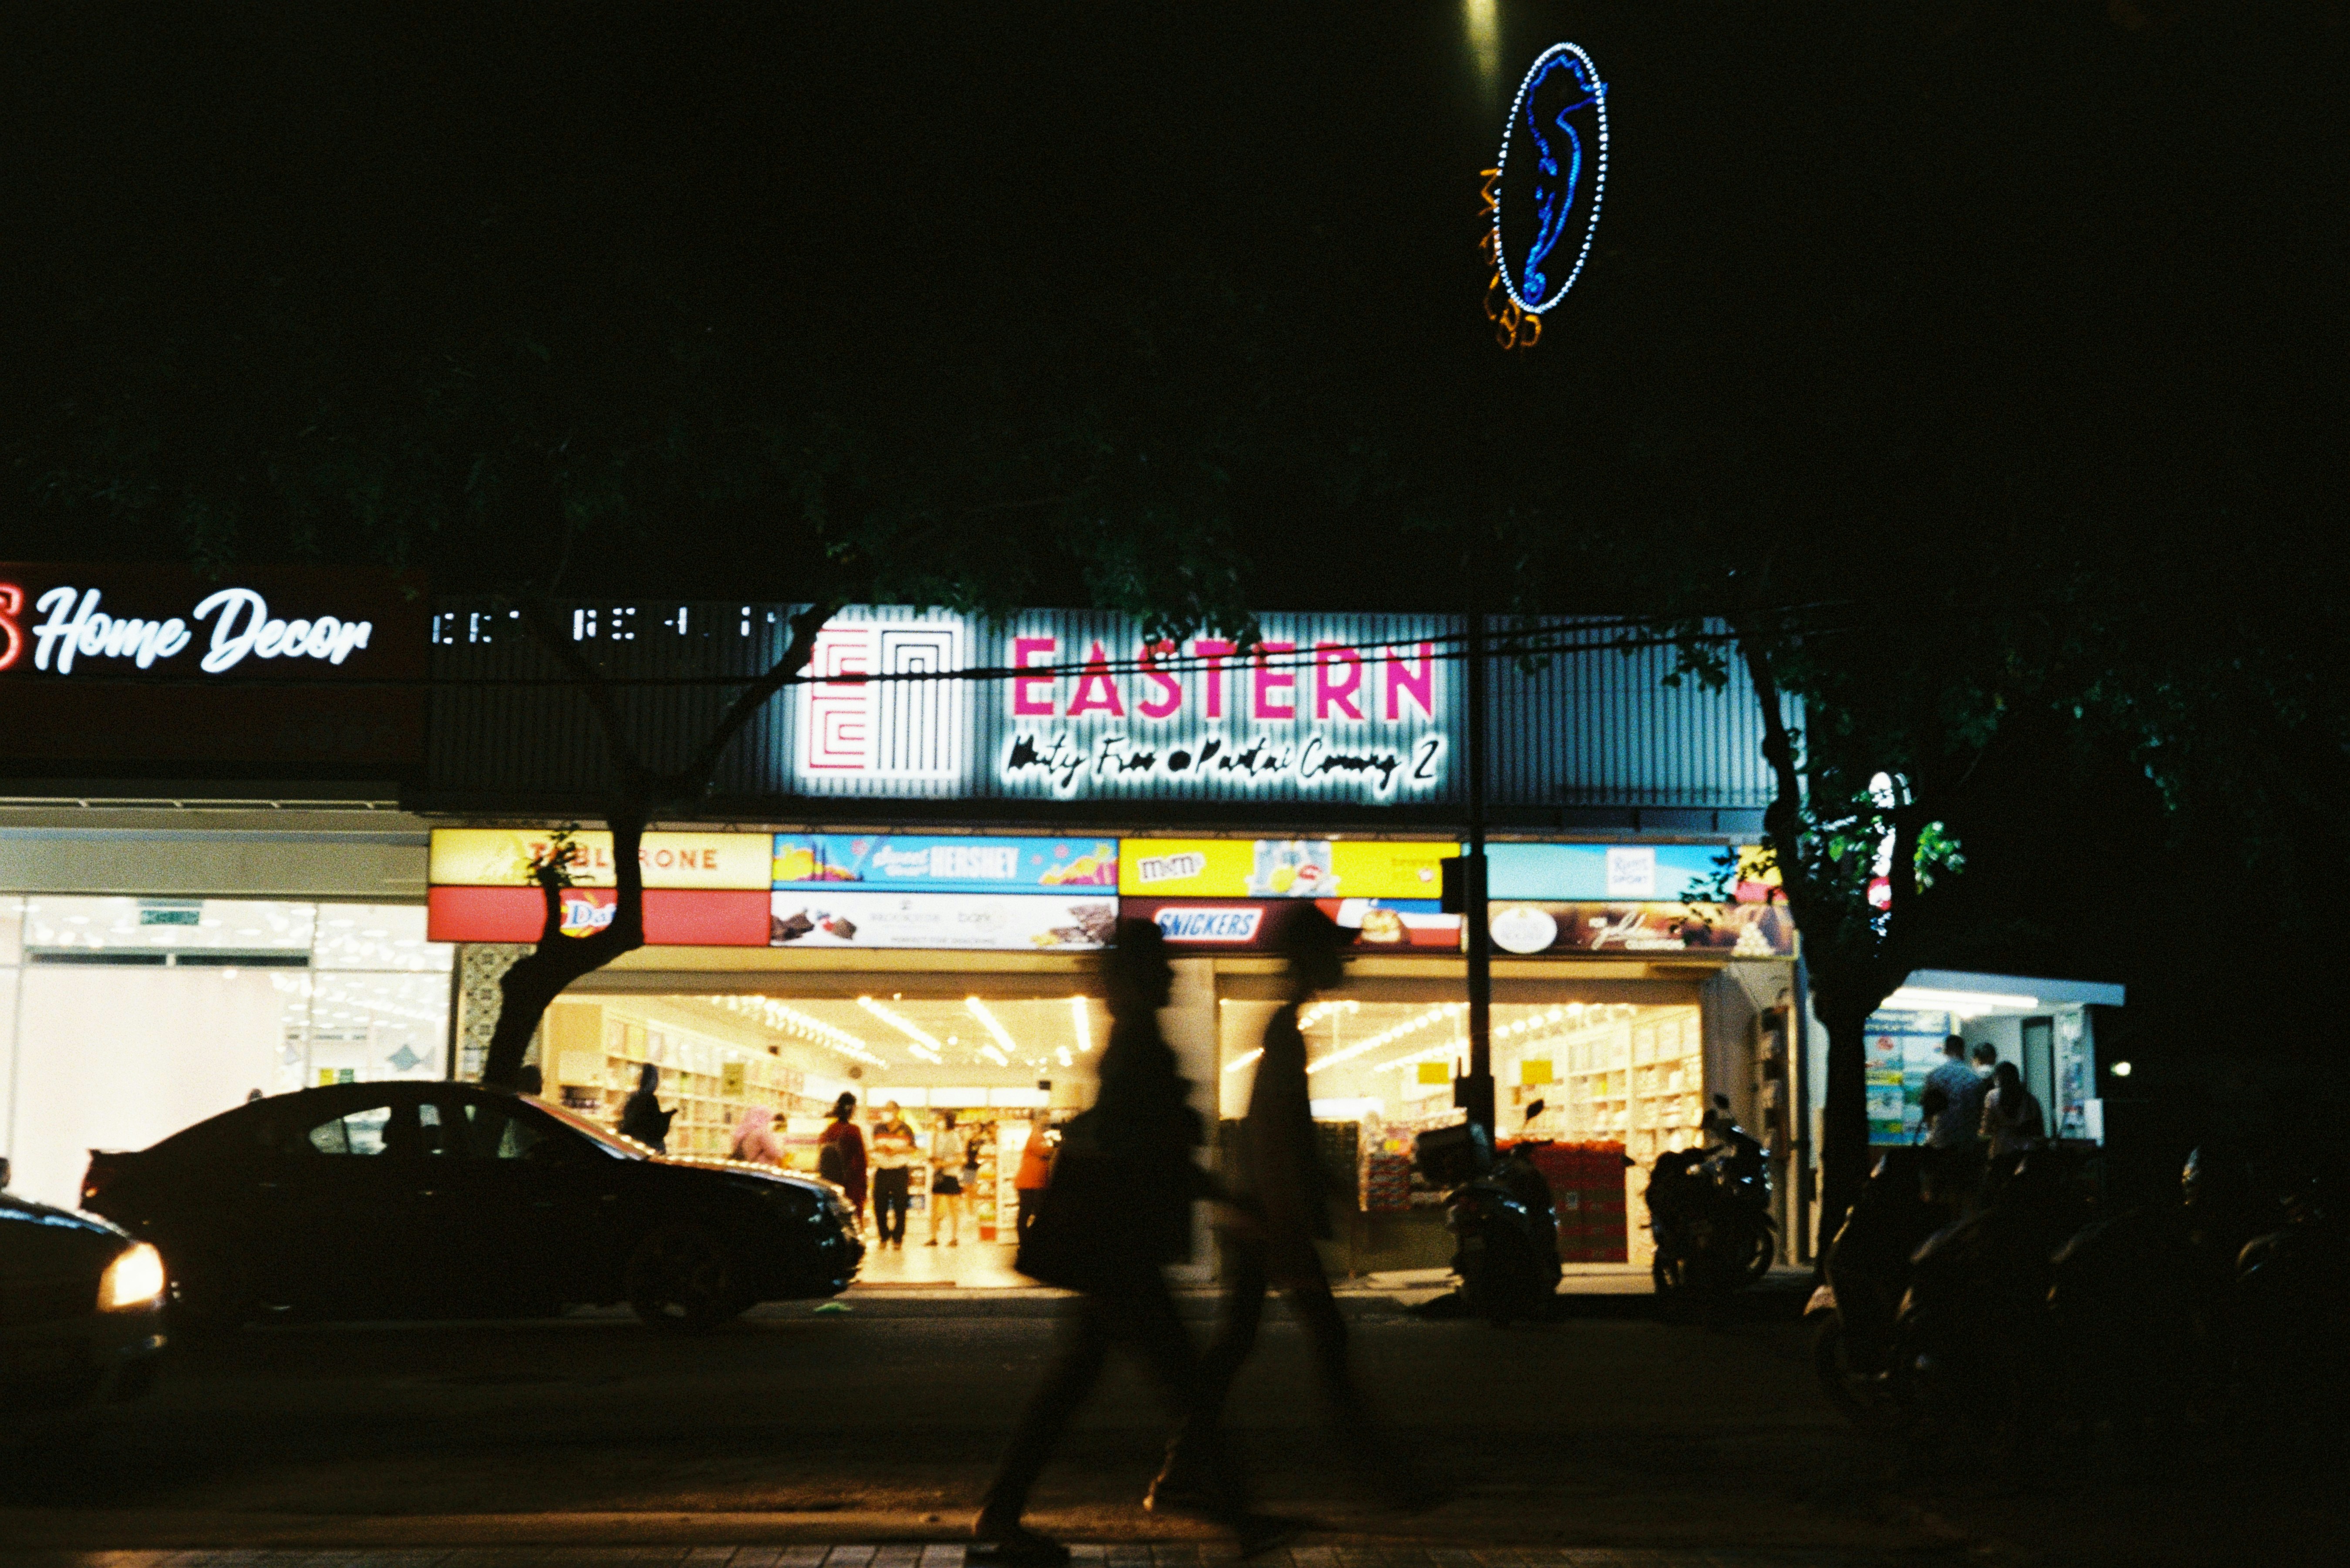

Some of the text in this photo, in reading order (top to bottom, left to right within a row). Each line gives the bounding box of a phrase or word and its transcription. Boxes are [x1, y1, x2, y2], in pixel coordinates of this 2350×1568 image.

[32, 586, 192, 674] Home
[193, 587, 373, 673] Decor
[1013, 637, 1434, 722] EASTERN
[1414, 740, 1440, 780] 2
[1158, 913, 1254, 936] SNICKERS
